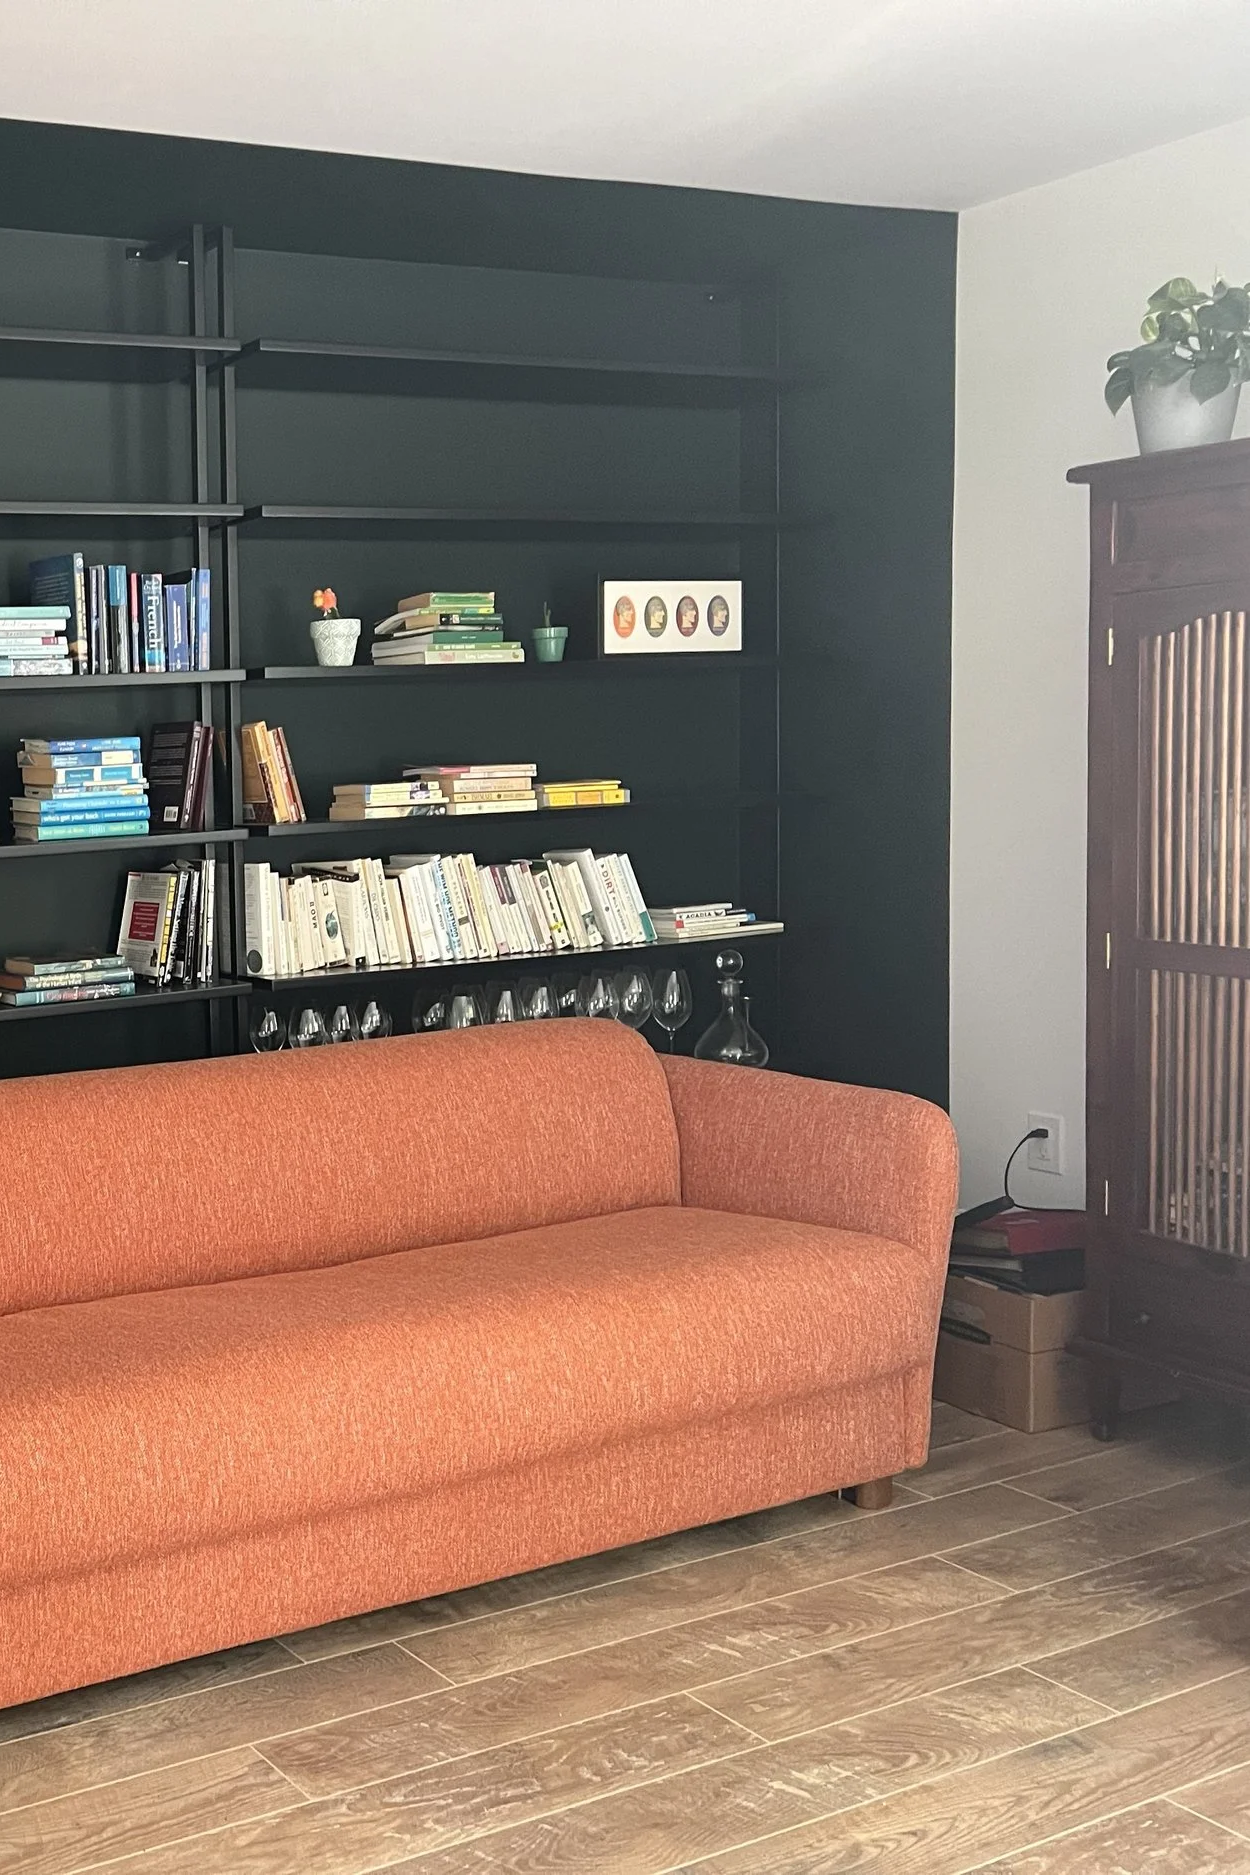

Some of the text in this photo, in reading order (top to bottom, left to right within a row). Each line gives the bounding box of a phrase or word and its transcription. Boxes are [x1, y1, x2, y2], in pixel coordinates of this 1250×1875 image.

[147, 596, 160, 649] French
[603, 870, 616, 895] DIRT
[310, 909, 318, 929] MAO
[685, 911, 712, 919] ACADIA
